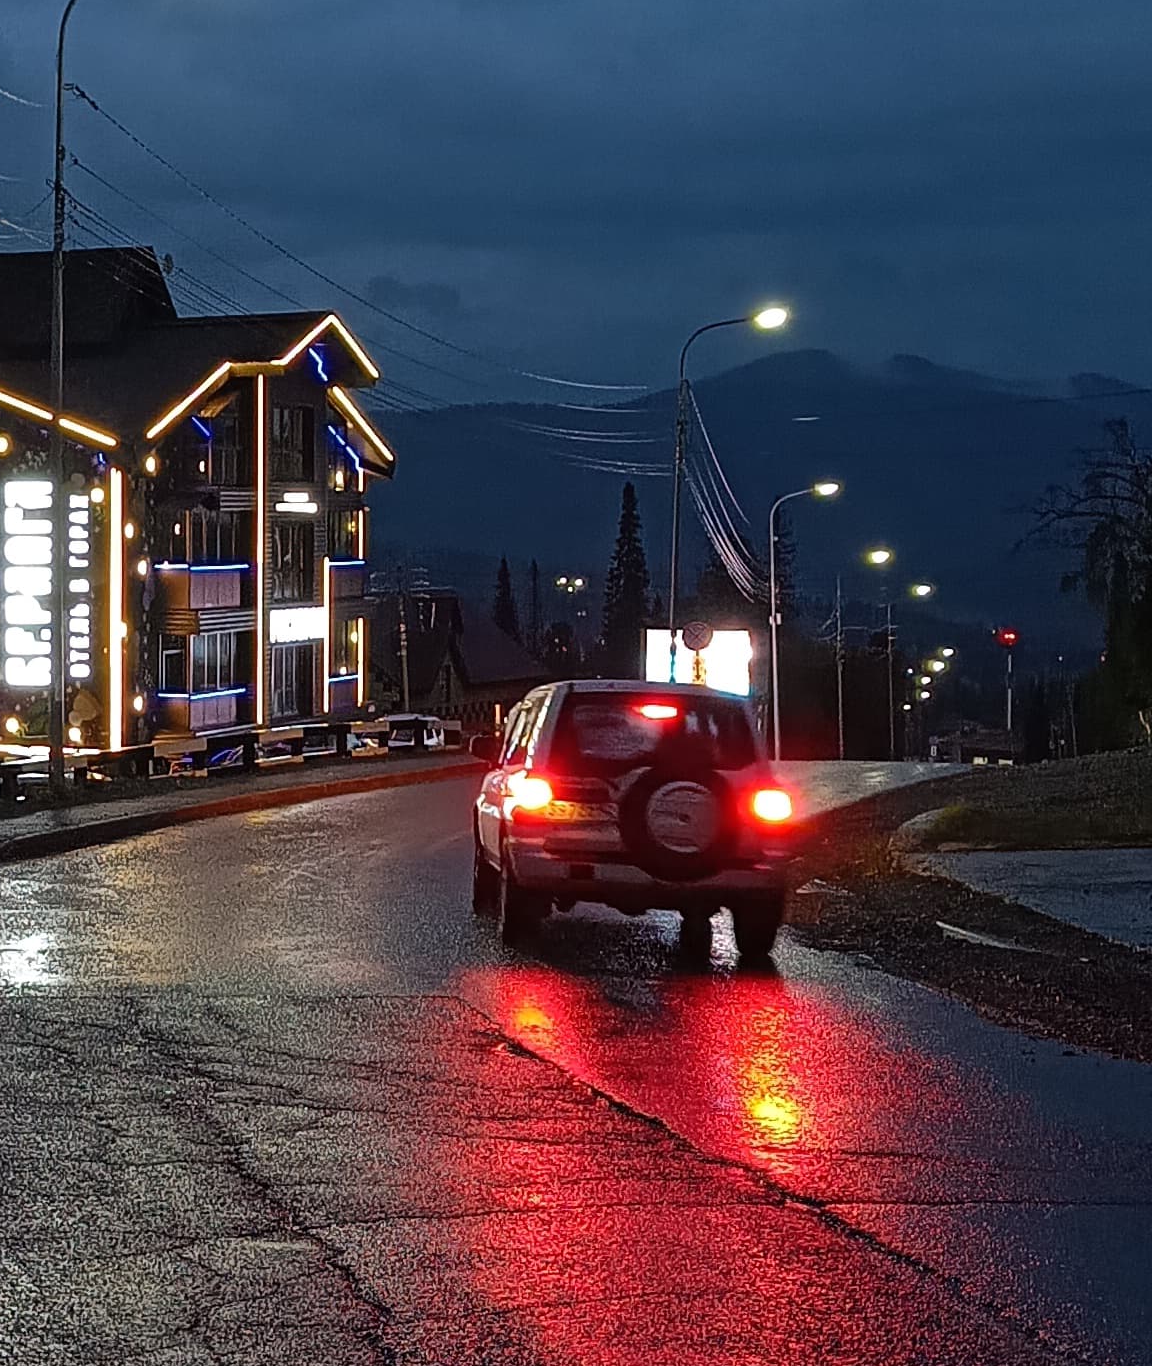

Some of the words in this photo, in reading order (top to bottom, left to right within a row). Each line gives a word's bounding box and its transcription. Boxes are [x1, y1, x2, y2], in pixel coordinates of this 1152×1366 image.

[68, 495, 90, 568] ГОРАХ
[69, 579, 89, 593] В
[69, 603, 90, 678] ОТЕЛЬ
